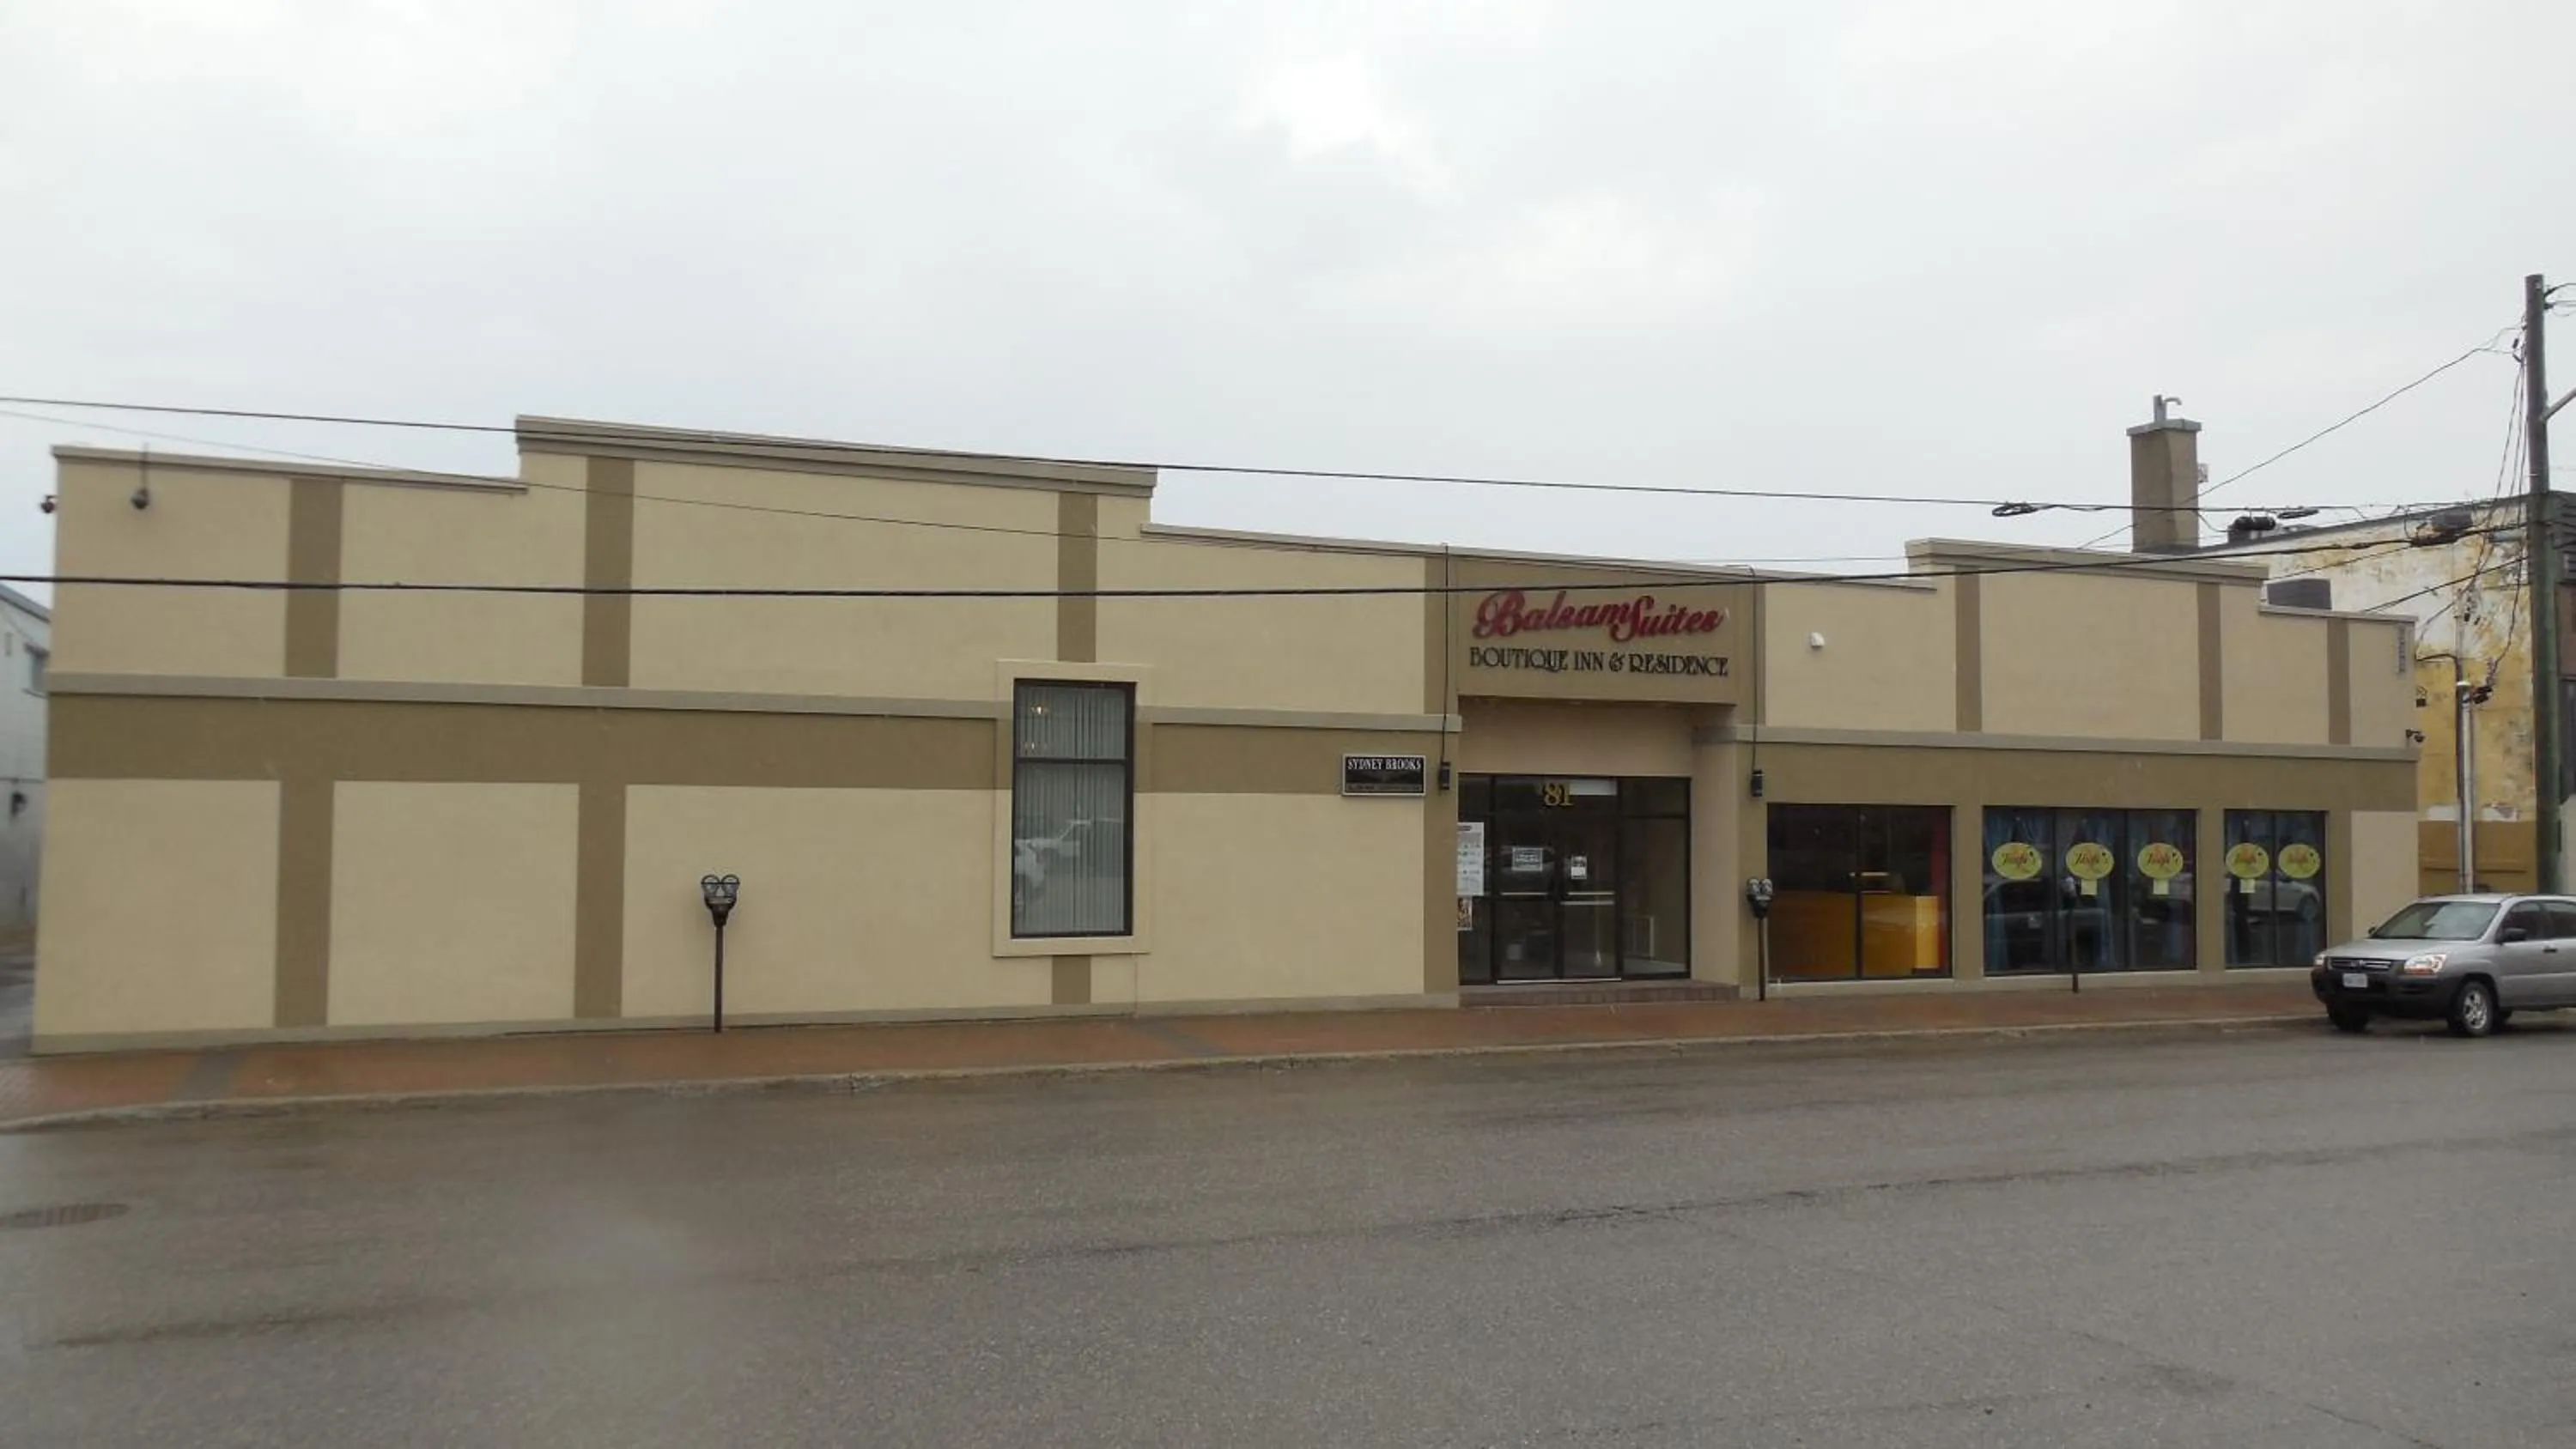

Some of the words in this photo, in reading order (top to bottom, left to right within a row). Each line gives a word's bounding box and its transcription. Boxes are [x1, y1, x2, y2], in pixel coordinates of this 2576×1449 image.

[1469, 647, 1569, 672] BOUTIQUE
[1574, 652, 1605, 672] INN
[1608, 652, 1625, 672] &
[1629, 653, 1728, 676] RESIDENCE
[1347, 759, 1382, 770] SYDNEY
[1385, 758, 1422, 770] BROOKS
[1543, 782, 1574, 806] 81
